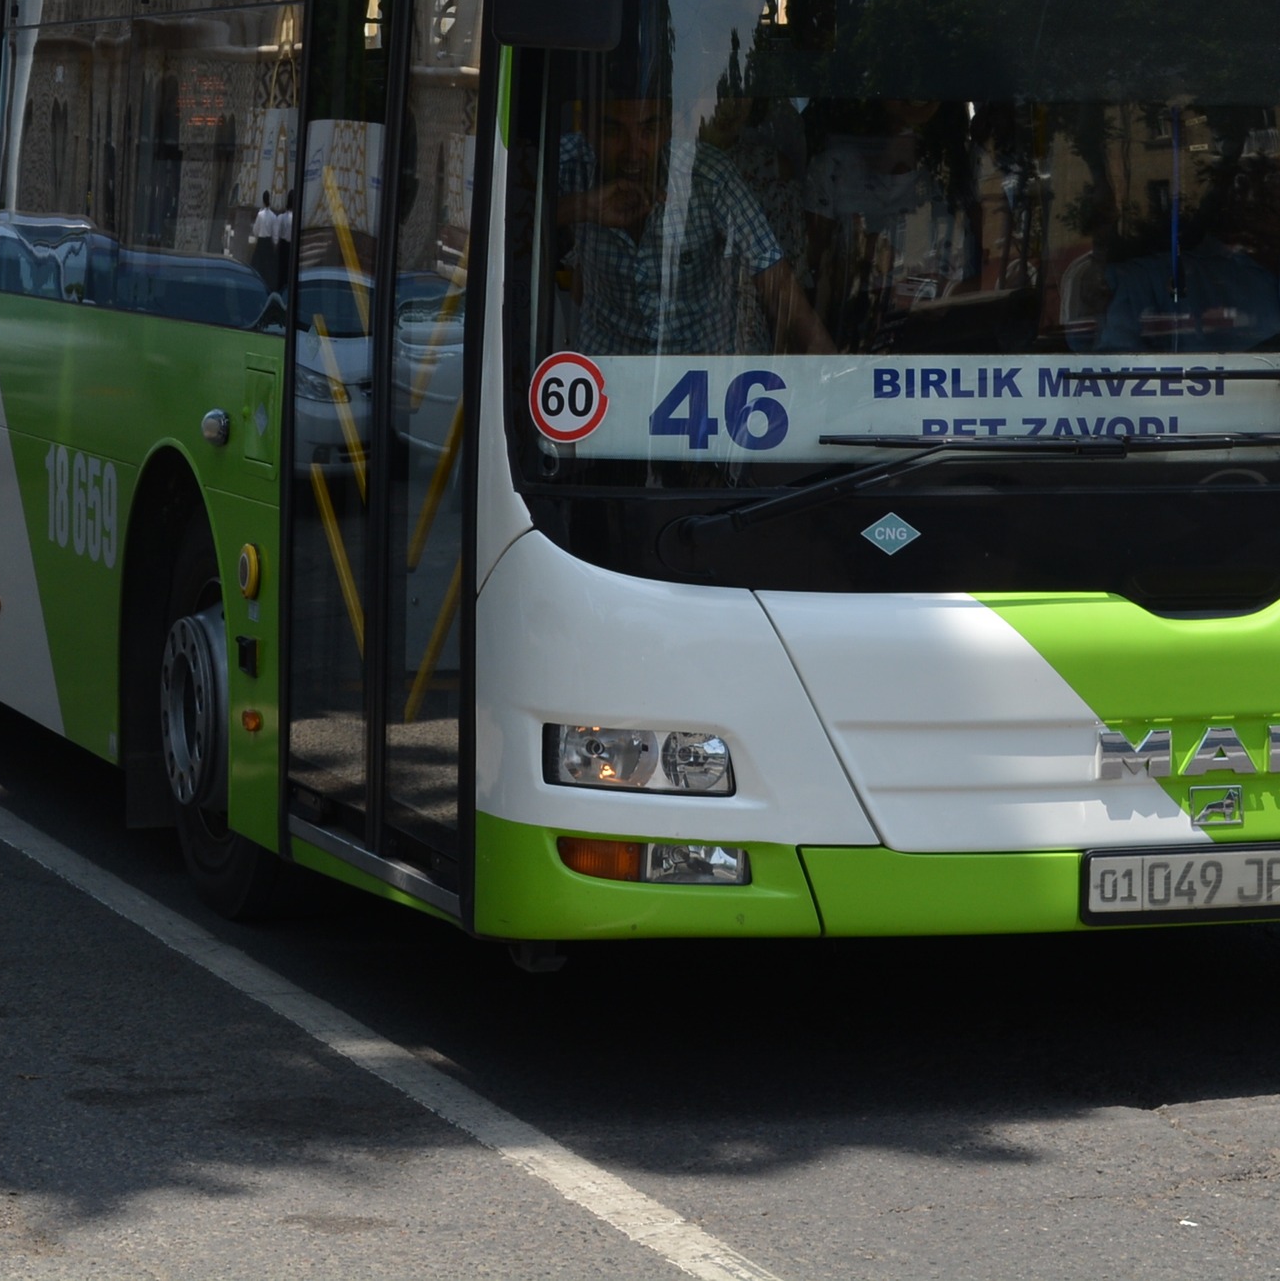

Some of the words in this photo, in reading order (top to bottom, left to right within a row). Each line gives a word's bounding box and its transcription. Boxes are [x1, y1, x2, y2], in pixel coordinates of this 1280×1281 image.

[541, 377, 594, 417] 60
[873, 367, 1023, 399] BIRLIK
[1038, 366, 1225, 398] MAVZESI
[649, 370, 789, 450] 46
[45, 443, 117, 569] 18659
[874, 527, 907, 540] CNG
[1099, 868, 1137, 903] 01
[1148, 860, 1223, 906] 049
